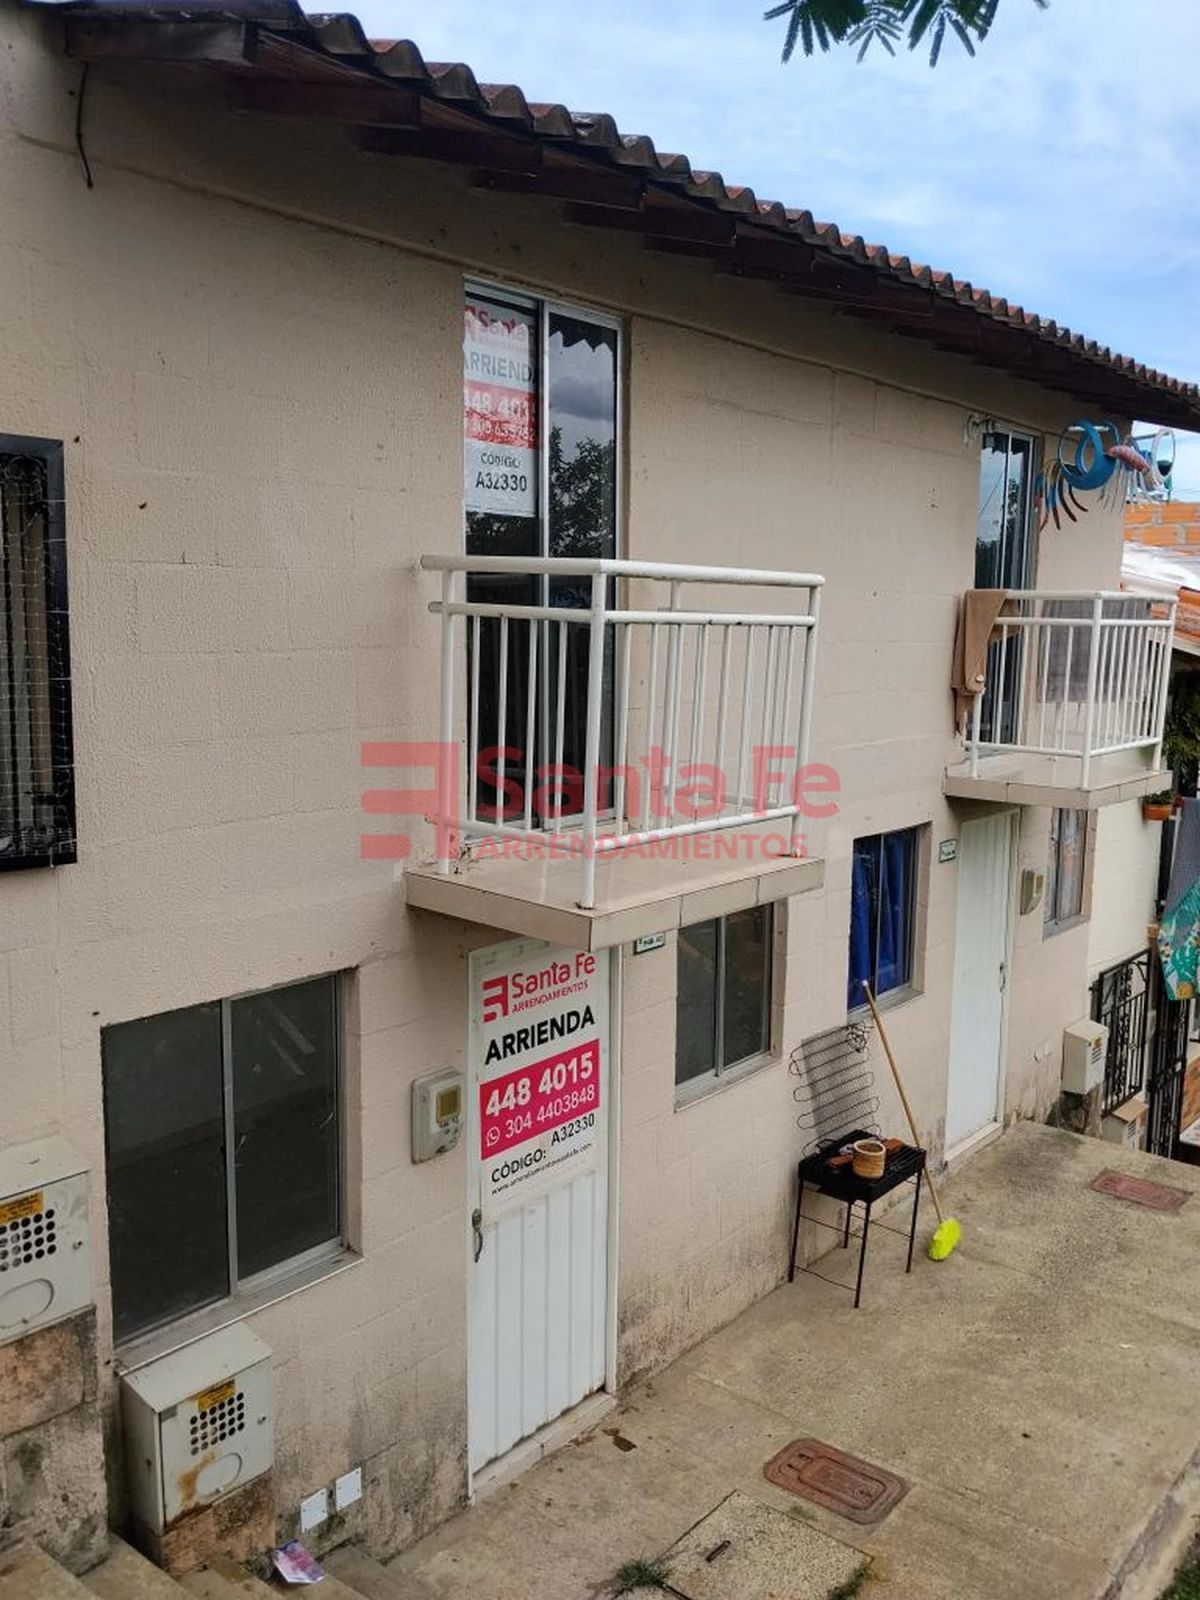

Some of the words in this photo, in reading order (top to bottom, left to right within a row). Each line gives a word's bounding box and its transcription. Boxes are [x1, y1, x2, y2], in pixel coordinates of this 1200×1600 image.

[464, 351, 536, 384] RRIEND
[475, 471, 527, 492] A32330
[511, 962, 570, 999] Santa
[575, 952, 596, 978] Fe
[512, 979, 588, 1014] ARRENDAMIENTOS
[484, 1005, 596, 1066] ARRIENDA
[485, 1077, 532, 1117] 448
[538, 1051, 594, 1095] 4015
[505, 1111, 533, 1138] 304
[536, 1084, 596, 1122] 4403848
[491, 1148, 547, 1183] CÓDIGO:
[551, 1112, 596, 1147] A32330
